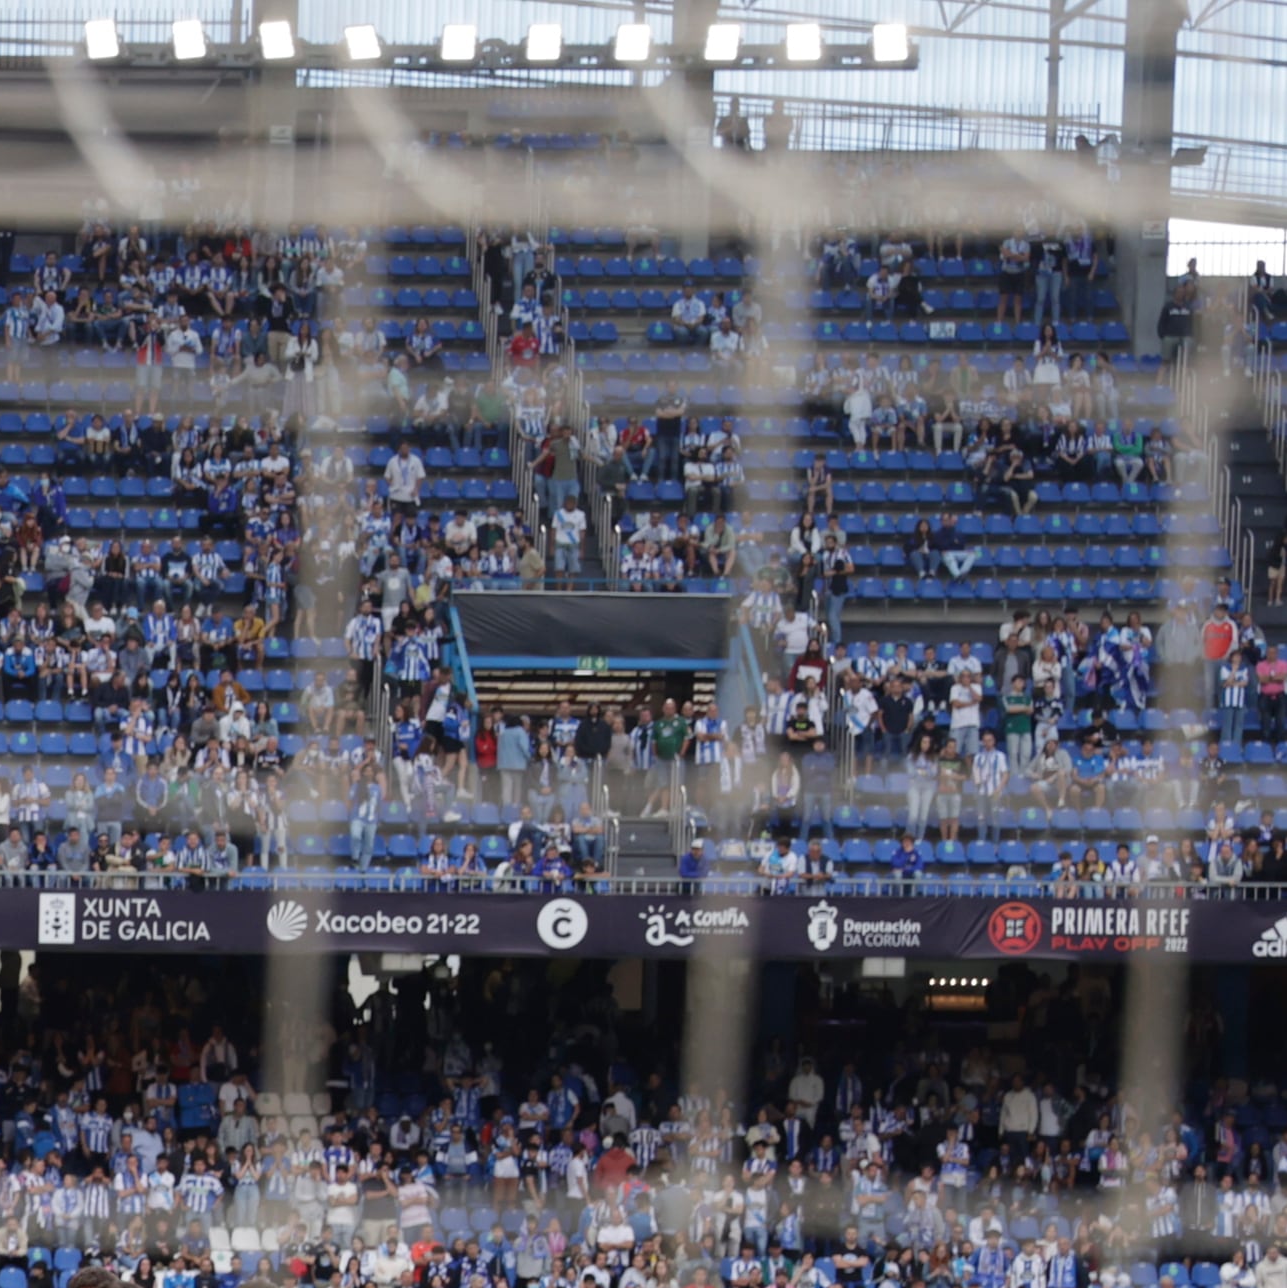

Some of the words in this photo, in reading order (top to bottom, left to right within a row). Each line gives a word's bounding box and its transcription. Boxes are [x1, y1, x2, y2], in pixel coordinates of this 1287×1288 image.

[82, 897, 162, 918] XUNTA
[675, 910, 690, 926] A
[82, 920, 111, 940] DE
[118, 921, 210, 942] GALICIA
[314, 909, 423, 935] Xacobeo
[843, 918, 921, 939] Deputación
[1051, 907, 1139, 935] PRIMERA
[1146, 909, 1190, 936] RFEF
[843, 934, 858, 947] DA
[862, 931, 921, 948] CORUÑA
[1051, 937, 1106, 951] PLAY
[1113, 937, 1160, 952] OFF
[1165, 937, 1189, 953] 2022
[1252, 938, 1287, 958] adi
